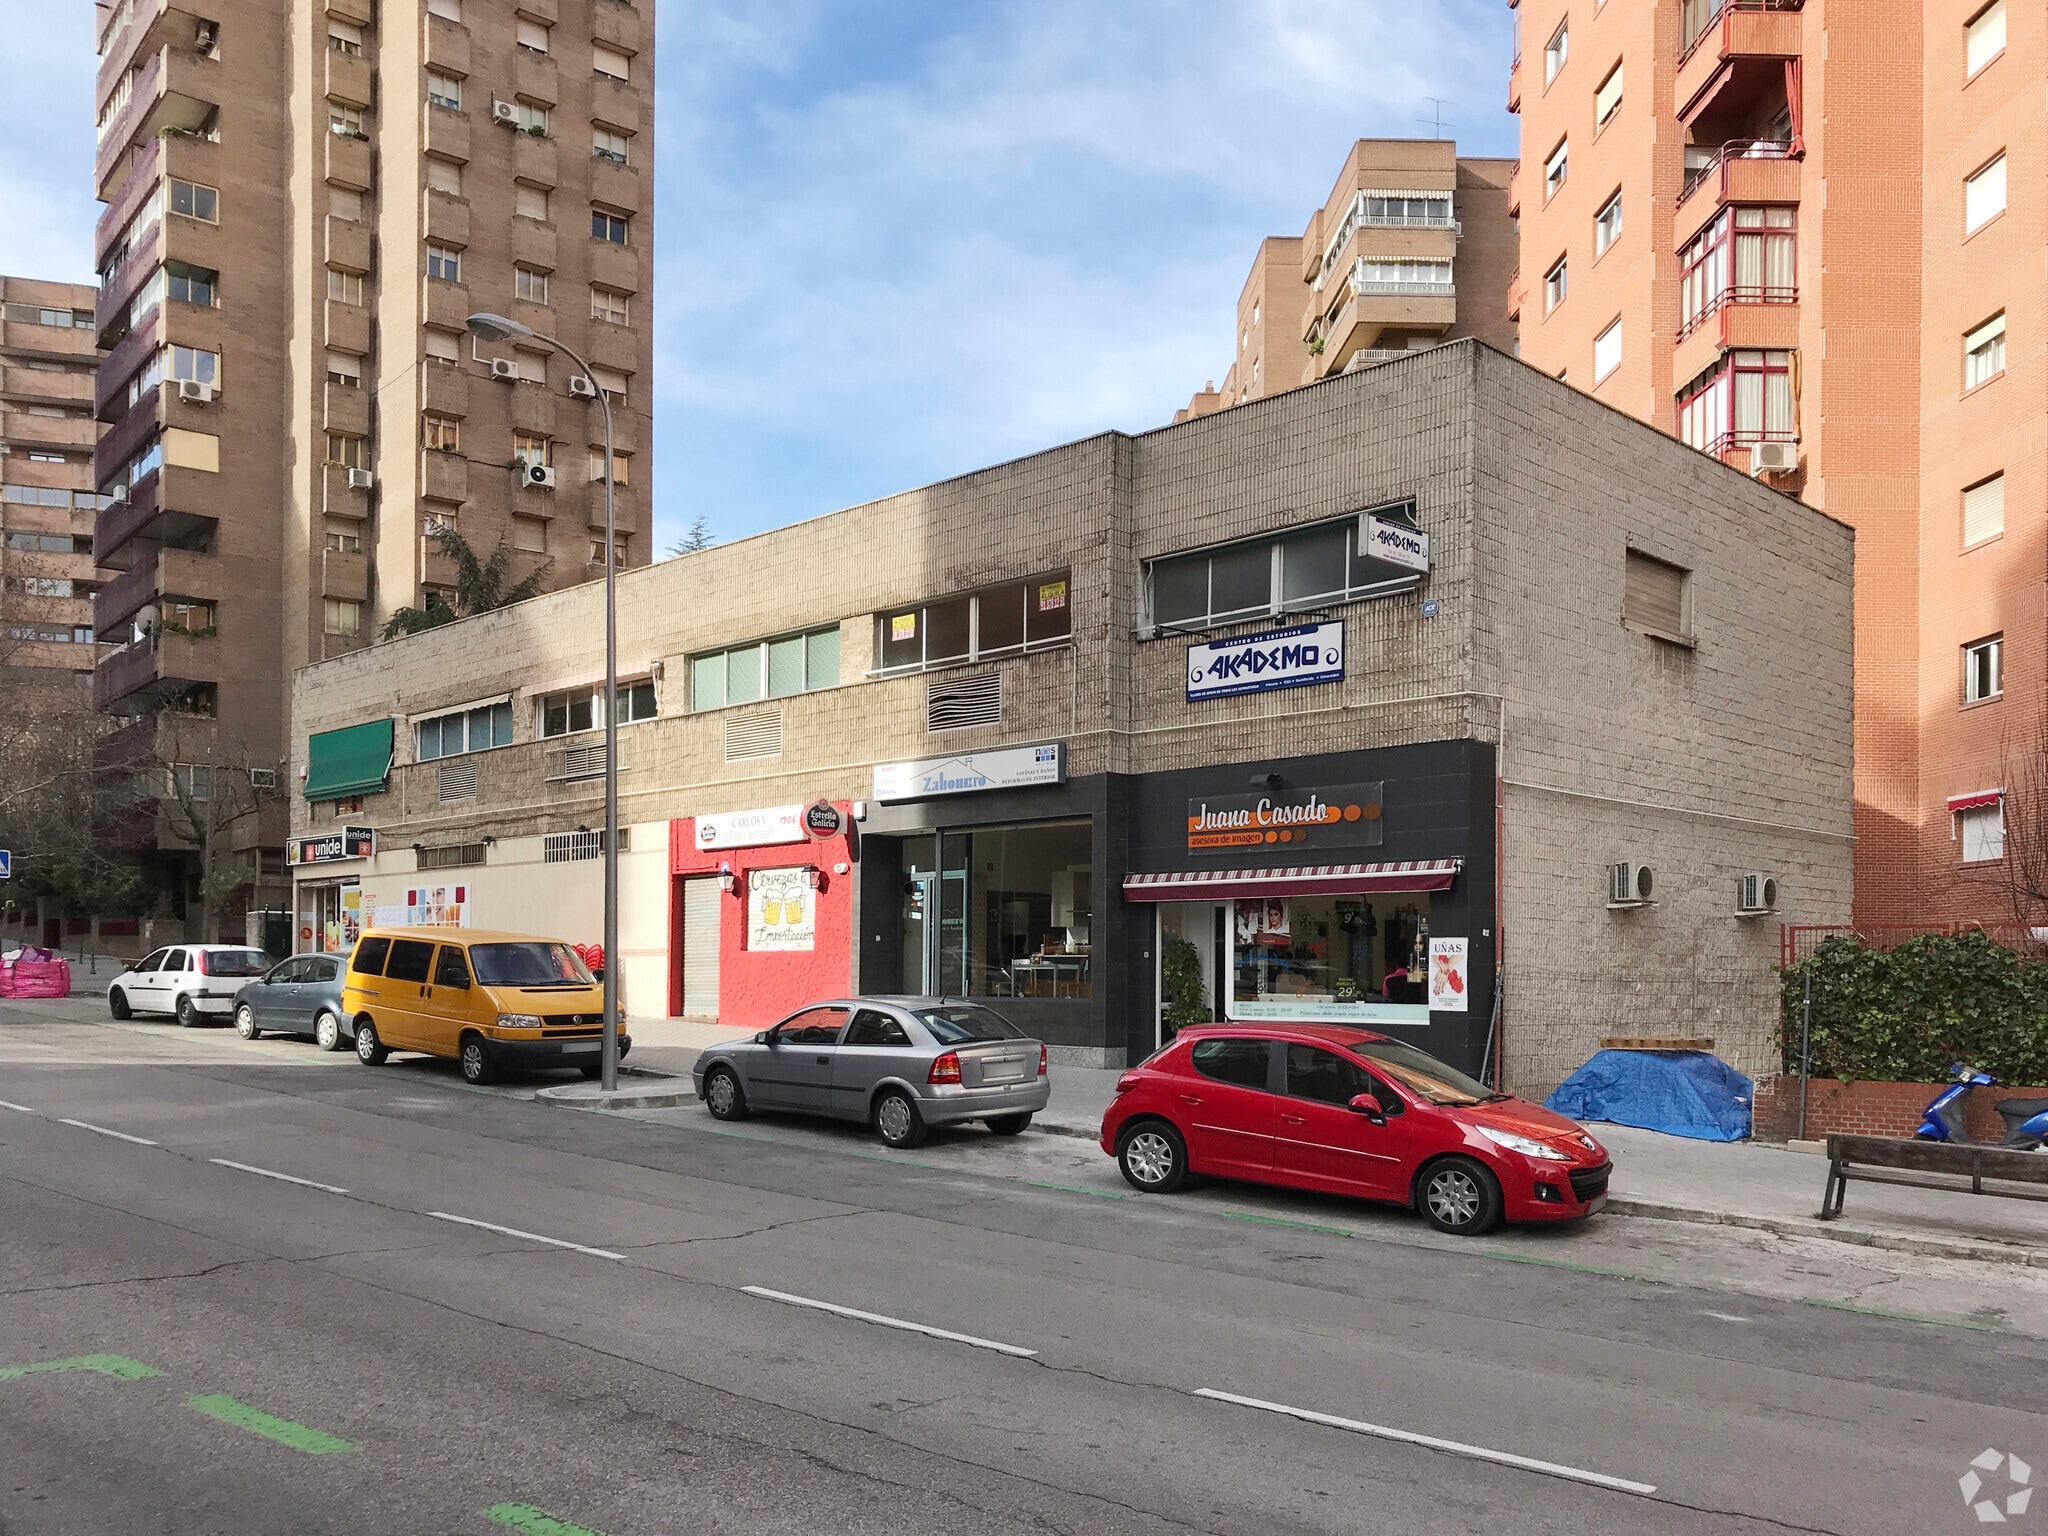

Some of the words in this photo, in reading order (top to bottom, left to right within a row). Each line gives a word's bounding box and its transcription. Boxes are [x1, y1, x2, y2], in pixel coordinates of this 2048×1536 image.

[1376, 529, 1420, 555] AKADEMO
[1225, 638, 1251, 647] CENTRO
[1266, 629, 1301, 641] ESTUDIOS
[1207, 643, 1319, 680] AKADEMO
[1035, 746, 1056, 756] naes
[810, 809, 837, 821] Estrella
[1194, 803, 1252, 831] Juana
[1256, 794, 1329, 826] Casado
[731, 816, 761, 829] CARLOS
[811, 817, 836, 829] Galicia
[346, 830, 372, 840] unide
[1191, 836, 1220, 845] asesora
[1220, 834, 1231, 844] de
[1231, 833, 1261, 844] imagen
[314, 838, 341, 857] unide
[751, 869, 799, 892] Cervezas
[754, 925, 815, 946] Importación
[1434, 941, 1463, 953] UÑAS
